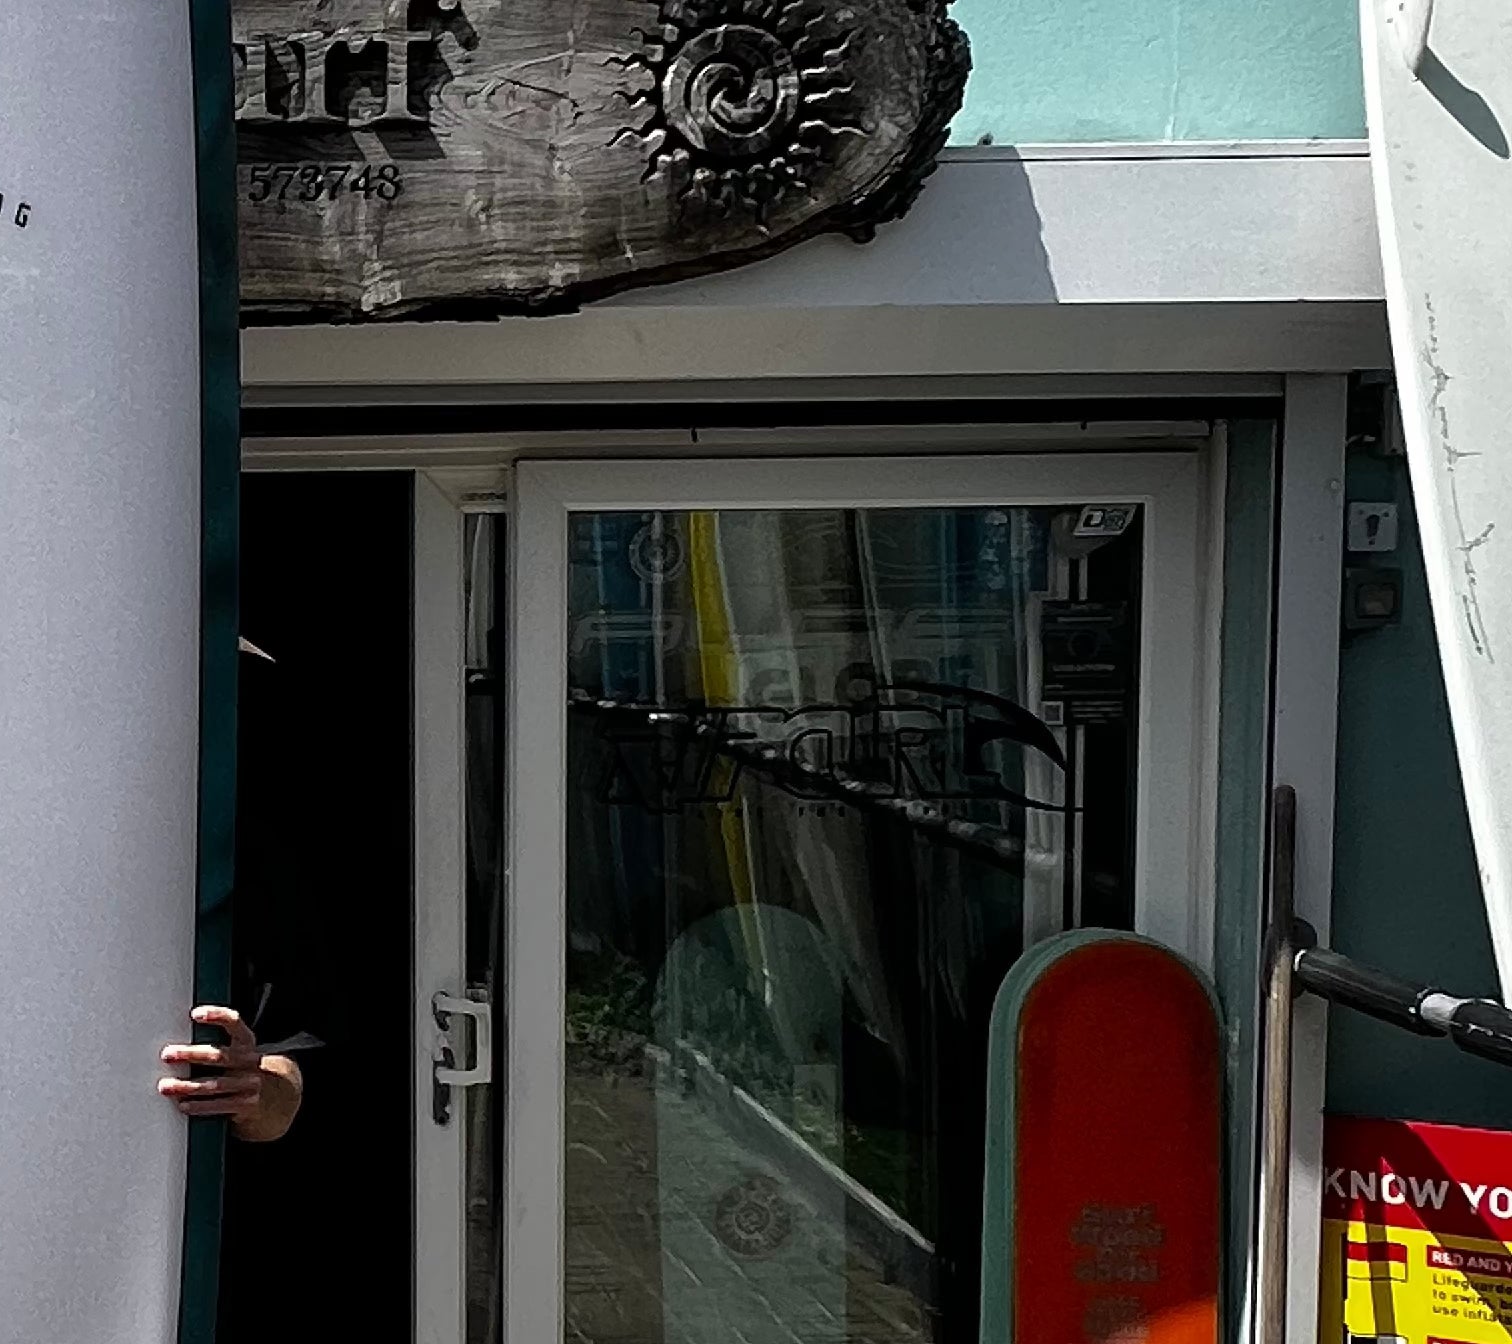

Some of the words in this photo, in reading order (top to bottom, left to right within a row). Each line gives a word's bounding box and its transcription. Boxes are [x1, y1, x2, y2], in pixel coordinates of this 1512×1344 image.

[248, 164, 399, 202] 573748
[1324, 1167, 1450, 1210] KNOW
[1432, 1250, 1463, 1266] RED
[1467, 1256, 1501, 1272] AND
